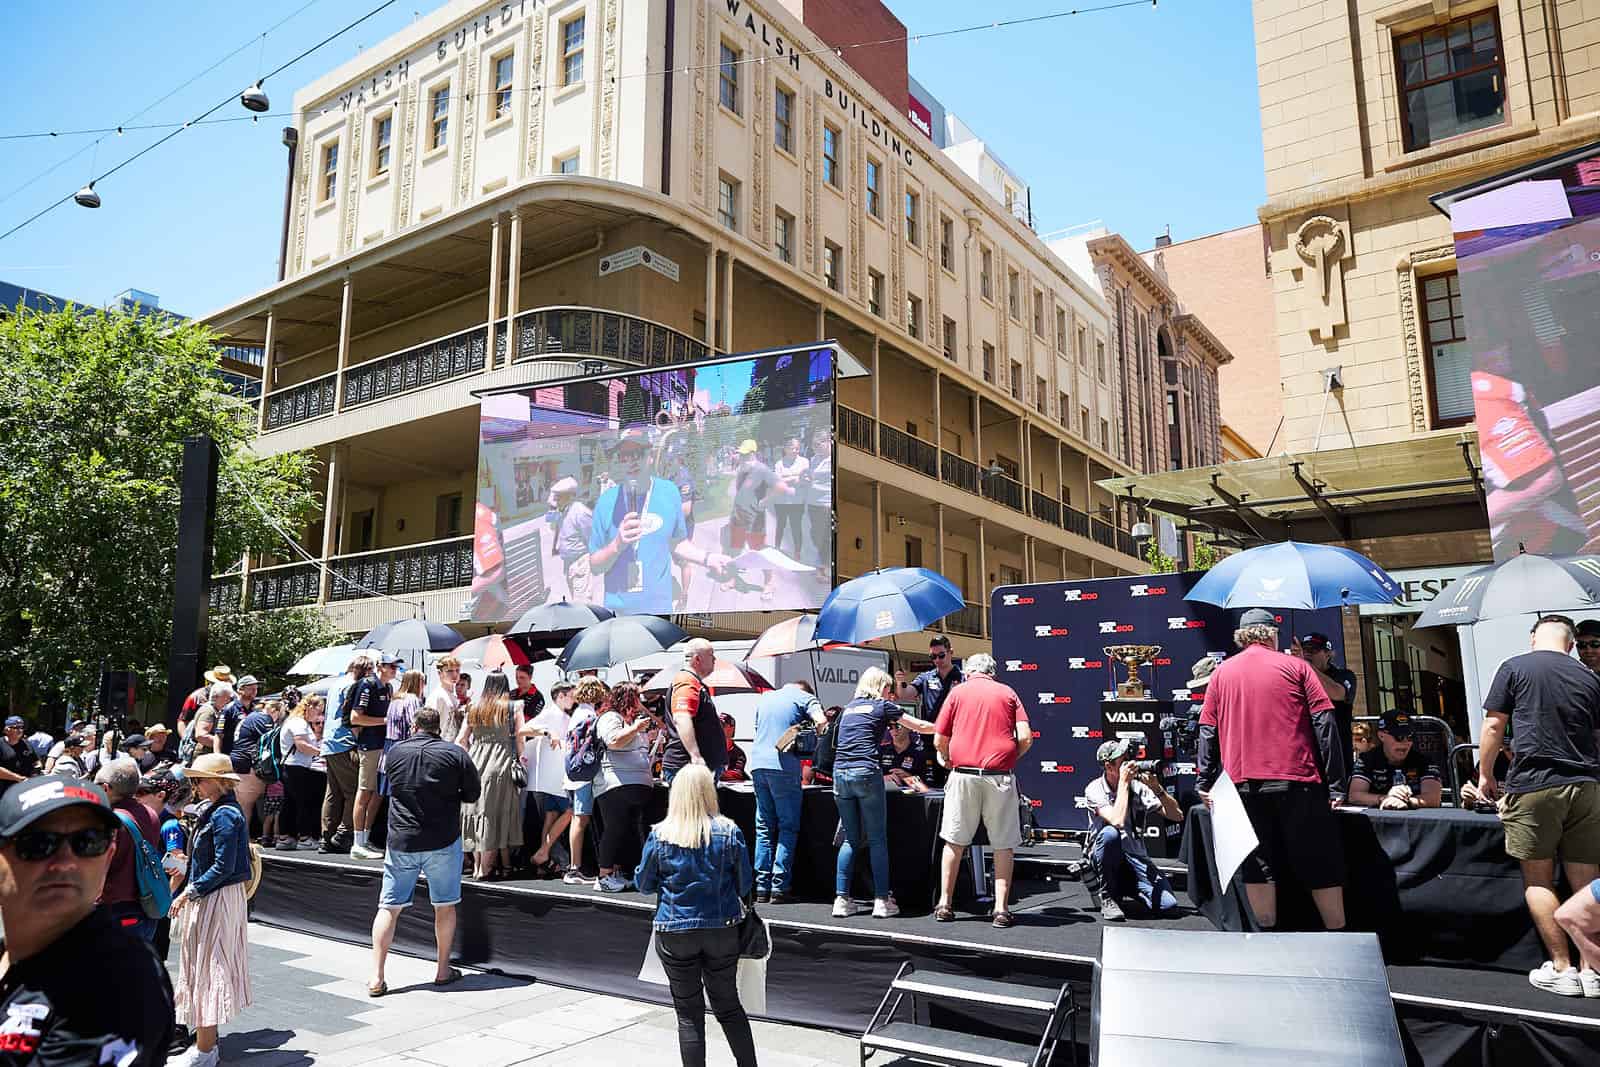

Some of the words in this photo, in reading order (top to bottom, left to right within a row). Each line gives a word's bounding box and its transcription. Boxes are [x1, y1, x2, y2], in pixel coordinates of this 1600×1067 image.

[339, 60, 409, 112] WALSH
[726, 0, 800, 71] WALSH
[825, 79, 913, 166] BUILDING
[816, 667, 859, 684] VAILO
[1105, 712, 1155, 723] VAILO
